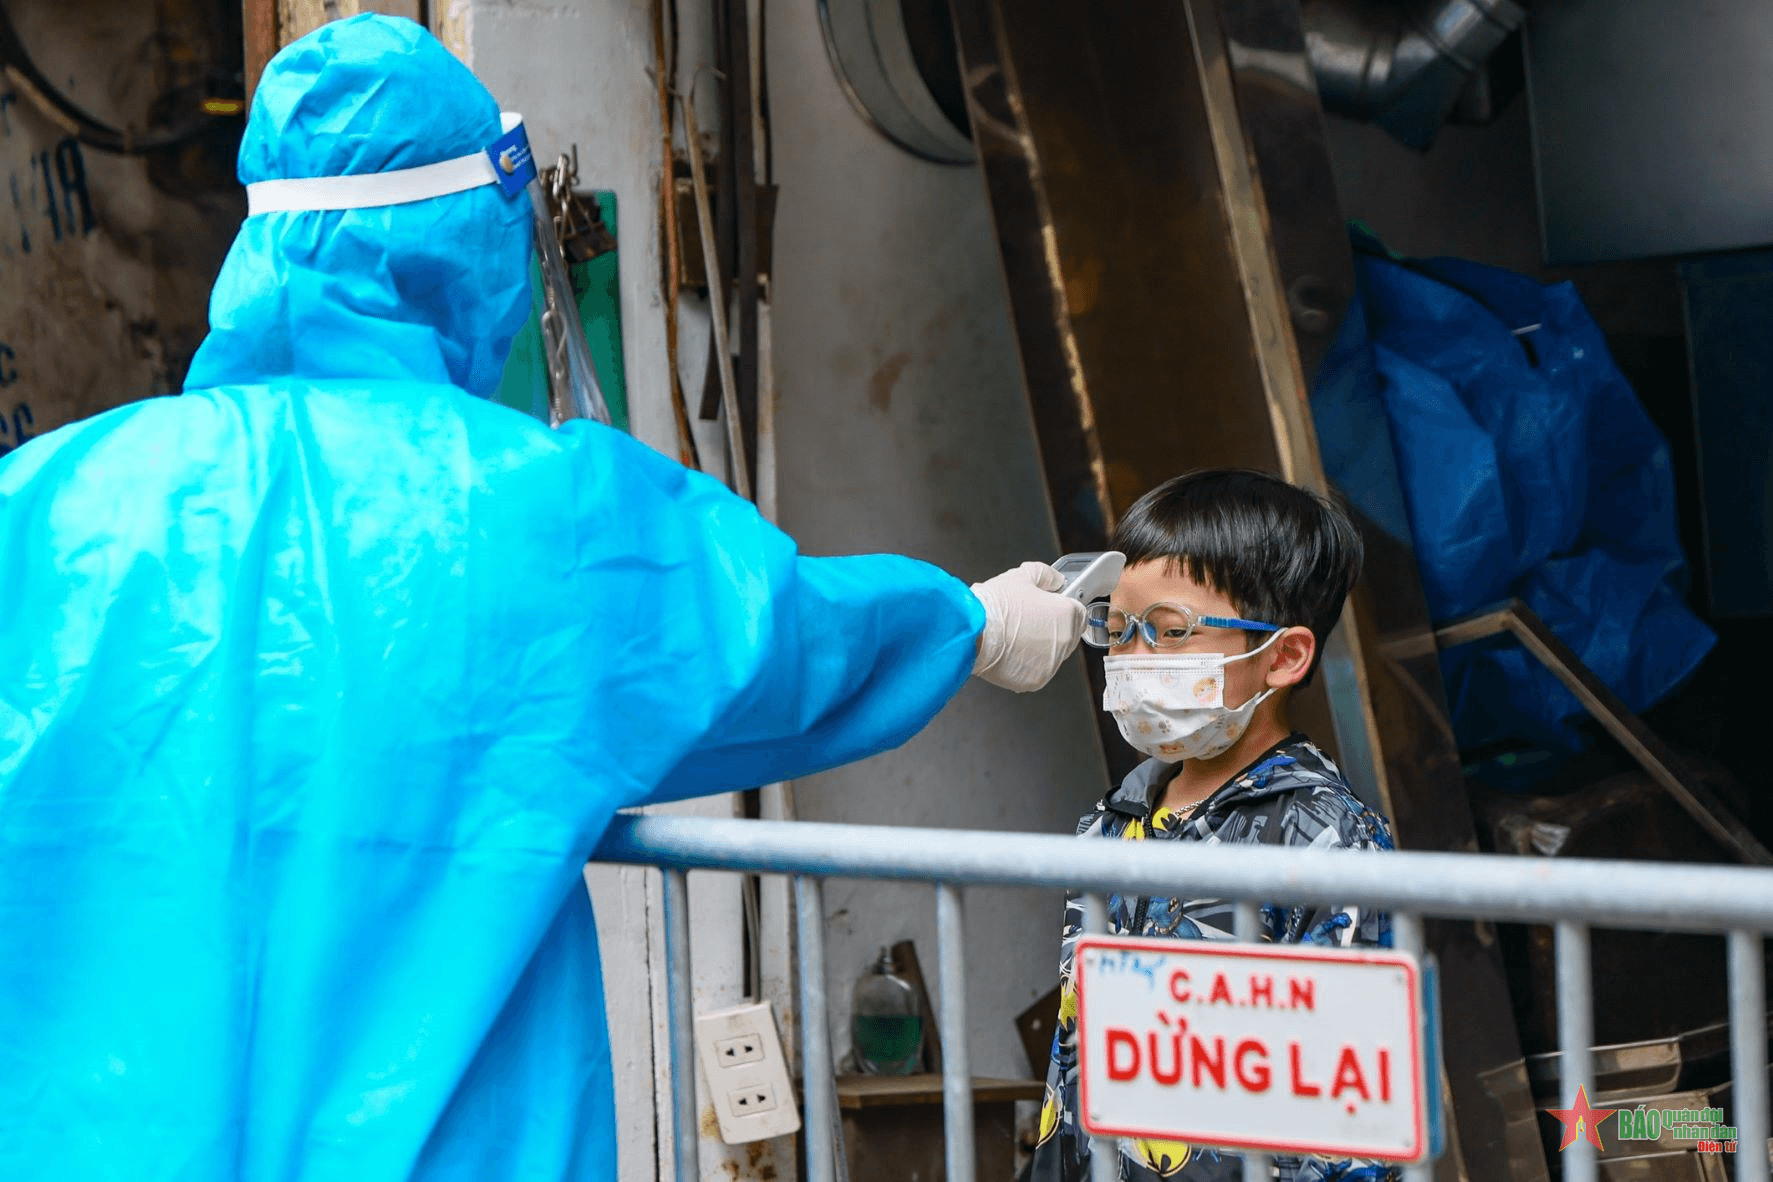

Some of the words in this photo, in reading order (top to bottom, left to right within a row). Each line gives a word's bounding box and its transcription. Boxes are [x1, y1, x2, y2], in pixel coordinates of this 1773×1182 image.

[1169, 968, 1316, 1011] C.A.H.N
[1105, 1010, 1273, 1093] DỪNG
[1288, 1043, 1392, 1114] LẠI
